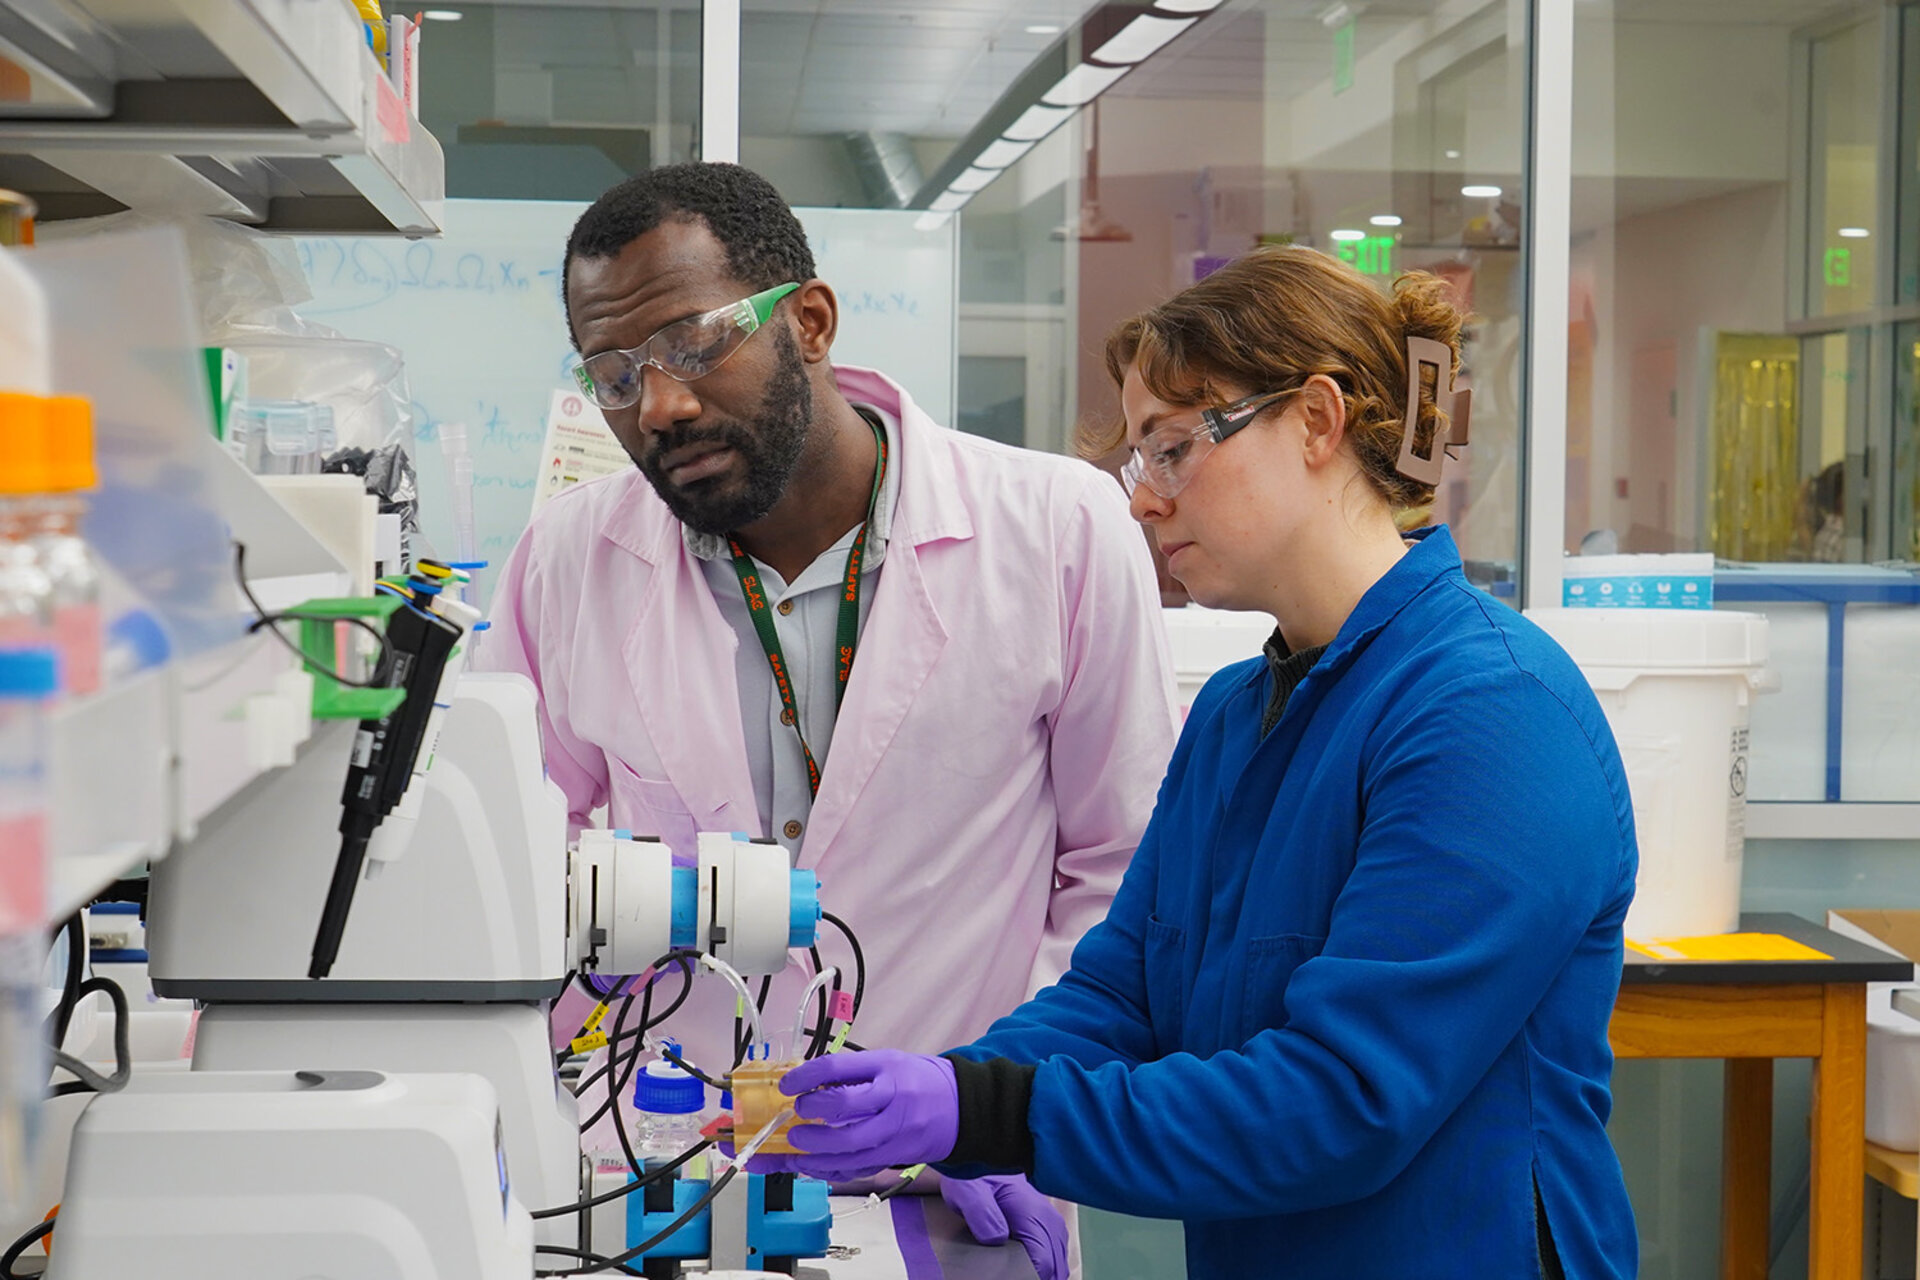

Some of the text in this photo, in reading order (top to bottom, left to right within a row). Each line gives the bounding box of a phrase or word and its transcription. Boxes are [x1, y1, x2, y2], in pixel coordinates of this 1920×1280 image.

[1338, 237, 1395, 275] EXIT
[845, 548, 862, 602] SAFETY
[743, 575, 764, 611] SLAC
[770, 653, 792, 705] SAFETY
[839, 645, 853, 682] SLAC
